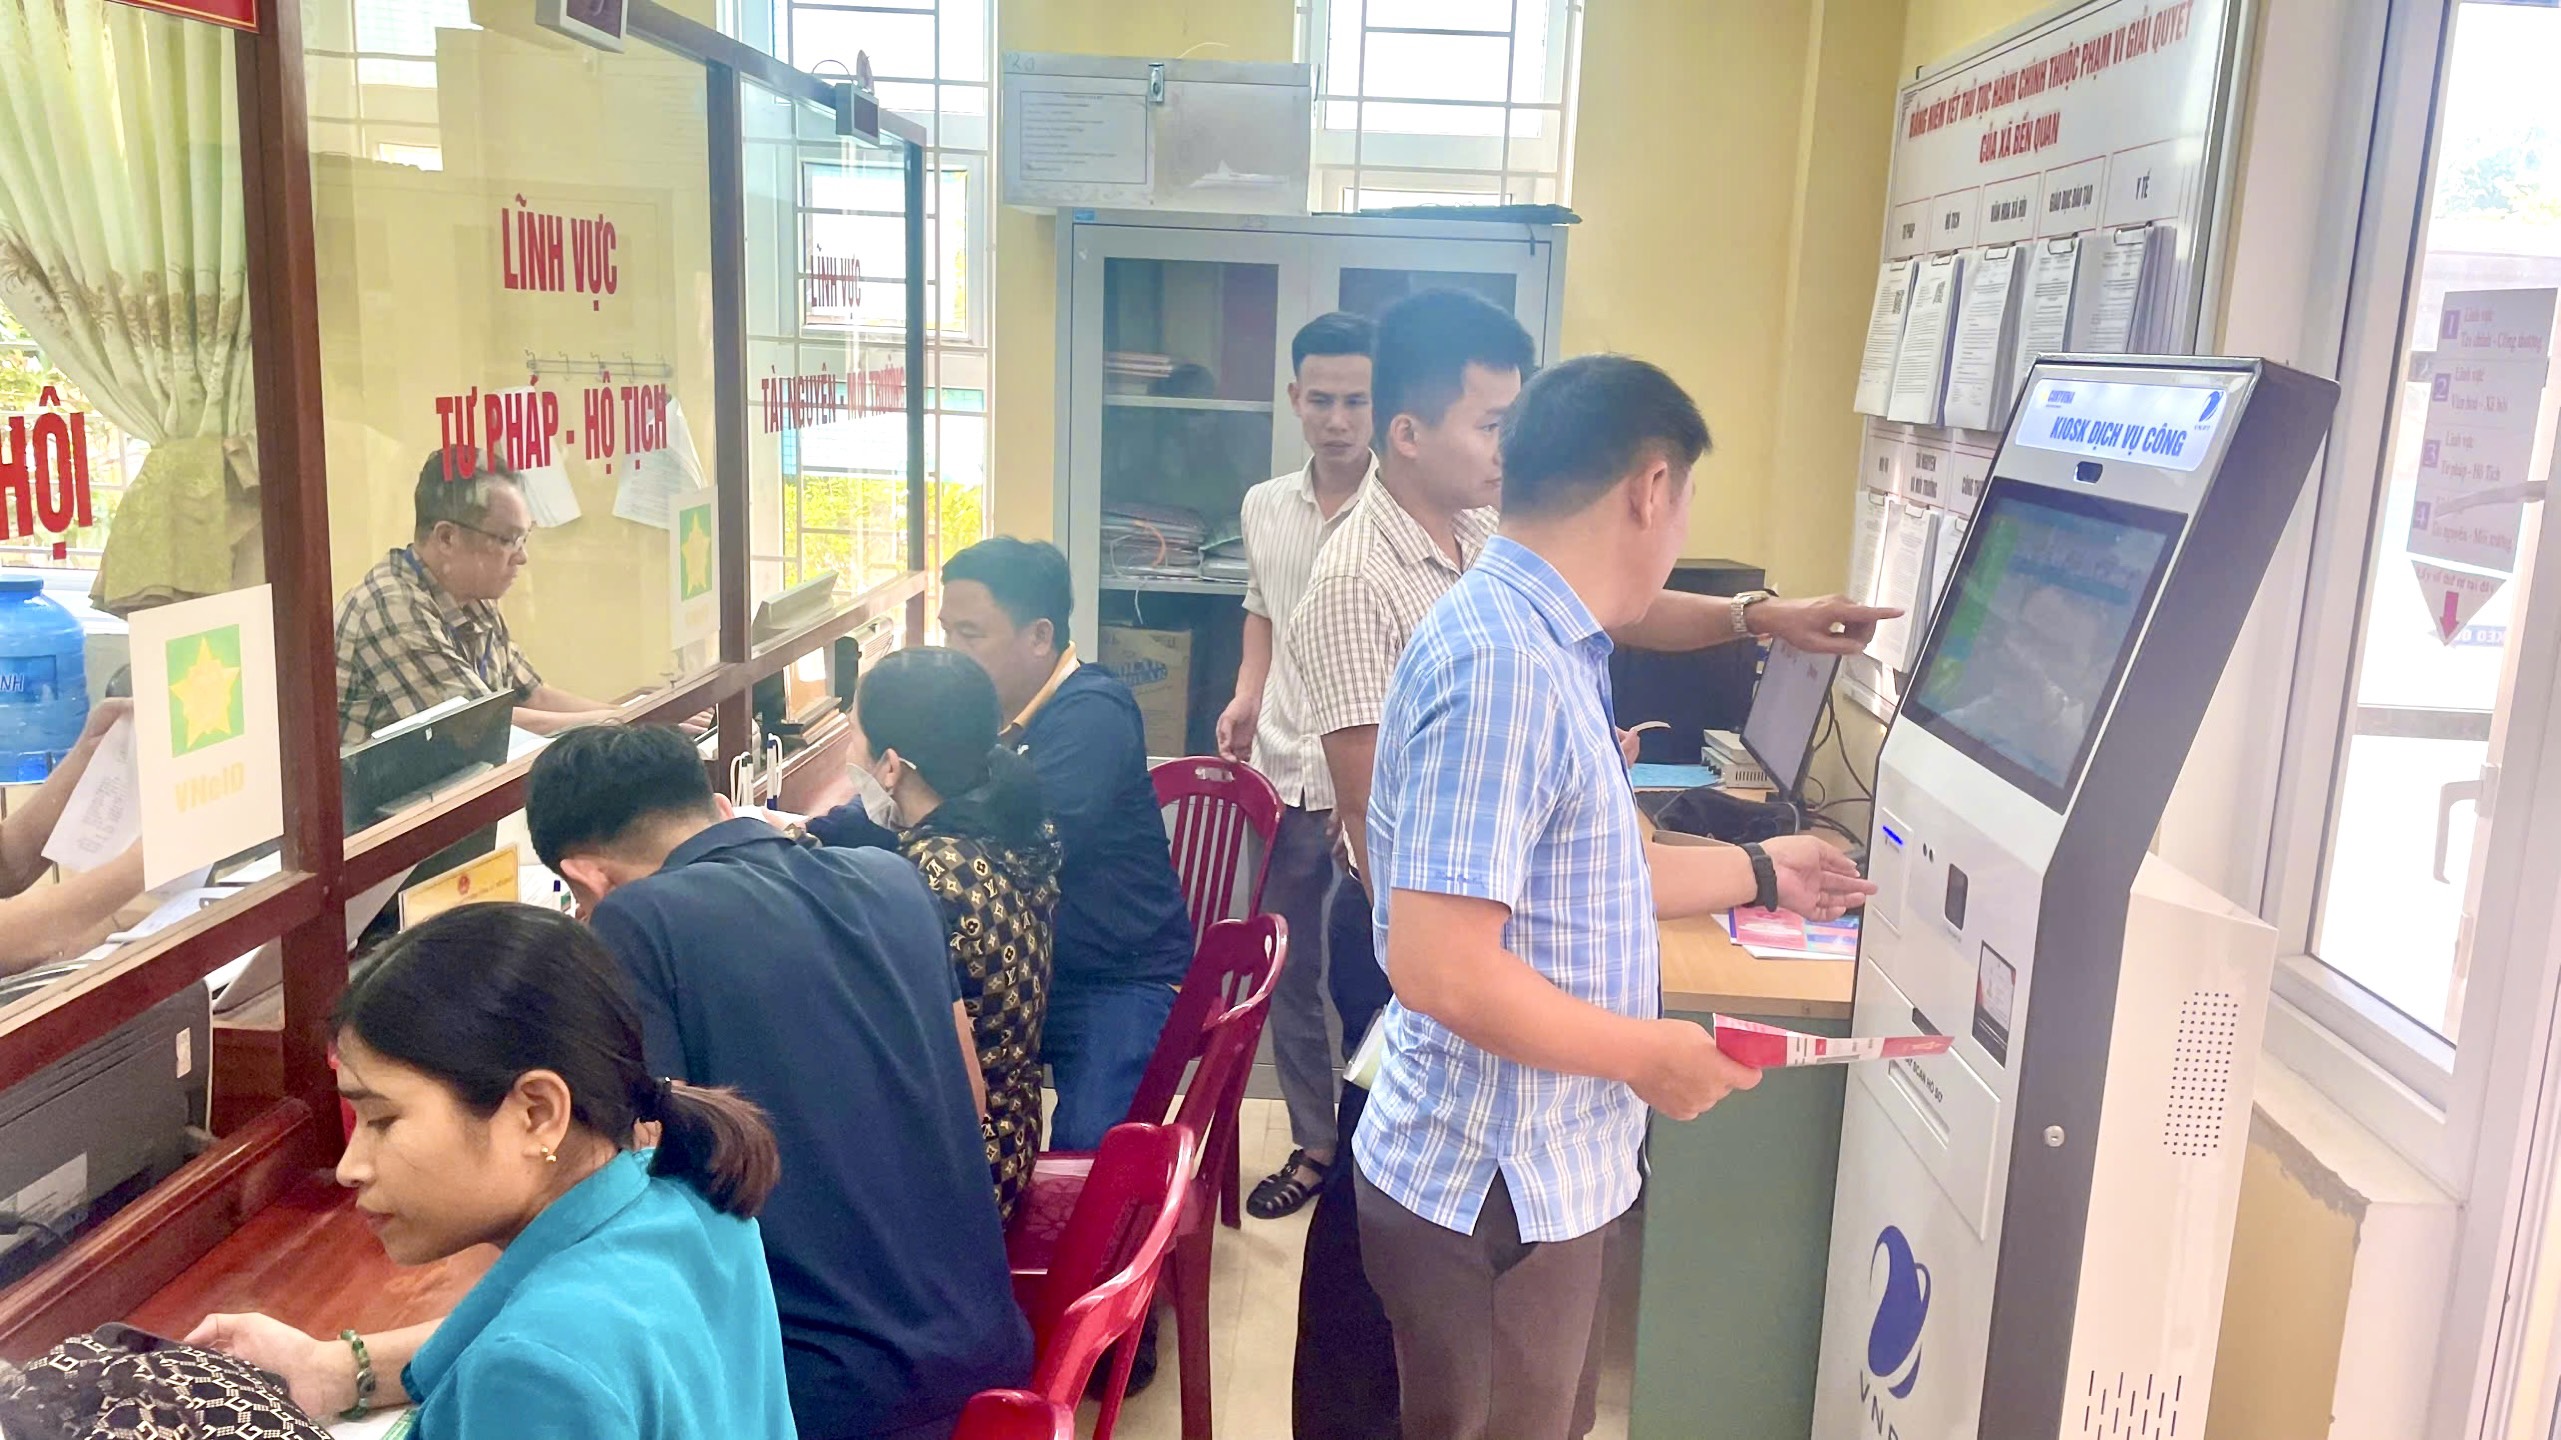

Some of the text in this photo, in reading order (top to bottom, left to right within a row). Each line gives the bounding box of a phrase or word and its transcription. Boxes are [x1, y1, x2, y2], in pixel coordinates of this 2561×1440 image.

[2048, 42, 2080, 91] THUỘC
[2080, 32, 2113, 80] PHẠM
[2113, 27, 2126, 65] VI
[2126, 5, 2152, 60] GIẢI
[1998, 120, 2013, 158] XÃ
[2012, 110, 2034, 155] BẾN
[2033, 112, 2061, 154] QUAN
[502, 193, 618, 312] LĨNH VỰC
[811, 243, 861, 319] LĨNH VỰC
[435, 386, 478, 482] TƯ
[484, 374, 559, 476] PHÁP
[584, 370, 615, 474] HỘ
[621, 383, 668, 470] TỊCH
[762, 364, 783, 433] TÀI
[788, 362, 836, 431] NGUYÊN
[0, 386, 93, 560] HỘI
[2050, 416, 2187, 457] KIOSK DỊCH VỤ CÔNG
[1912, 1061, 1926, 1084] SCAN
